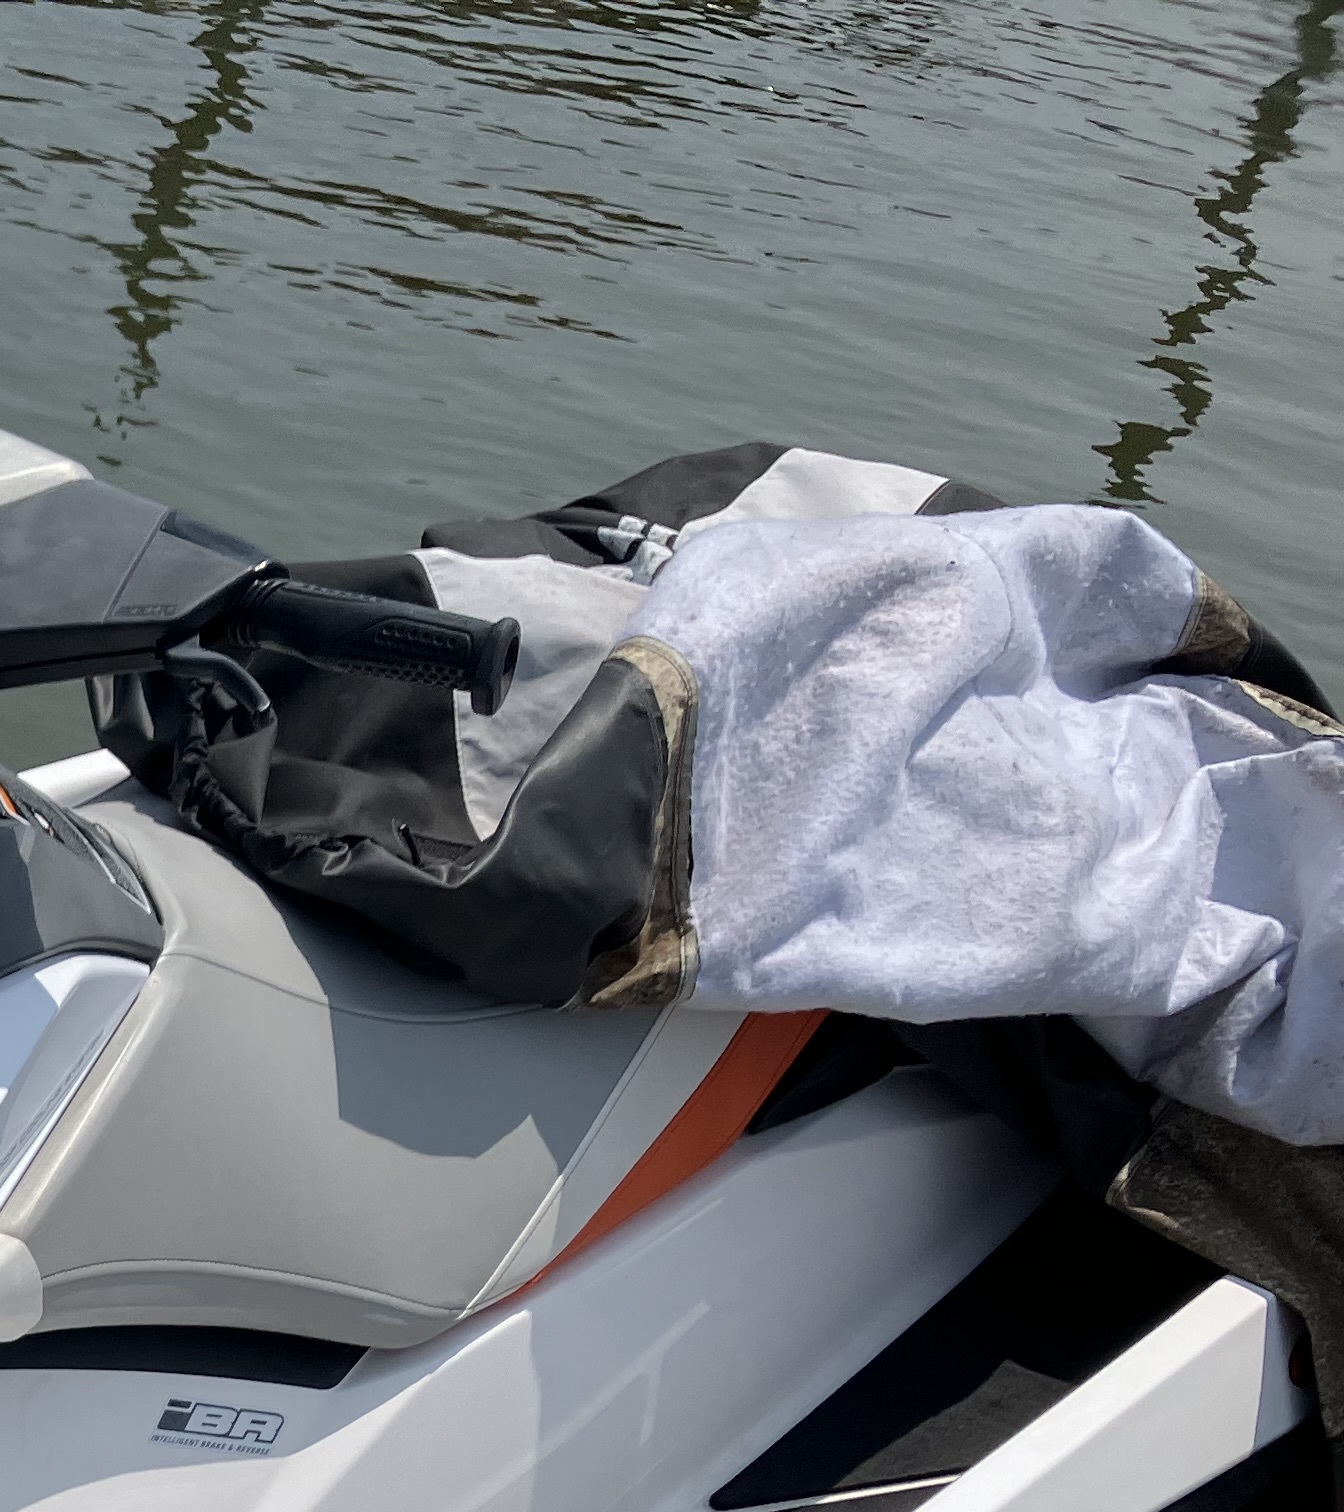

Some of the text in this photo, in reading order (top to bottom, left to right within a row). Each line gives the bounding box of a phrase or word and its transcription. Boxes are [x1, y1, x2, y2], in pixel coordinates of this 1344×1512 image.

[151, 1434, 199, 1448] INTELLIGENT
[200, 1440, 227, 1451] BRAKE
[235, 1445, 271, 1456] REVERSE
